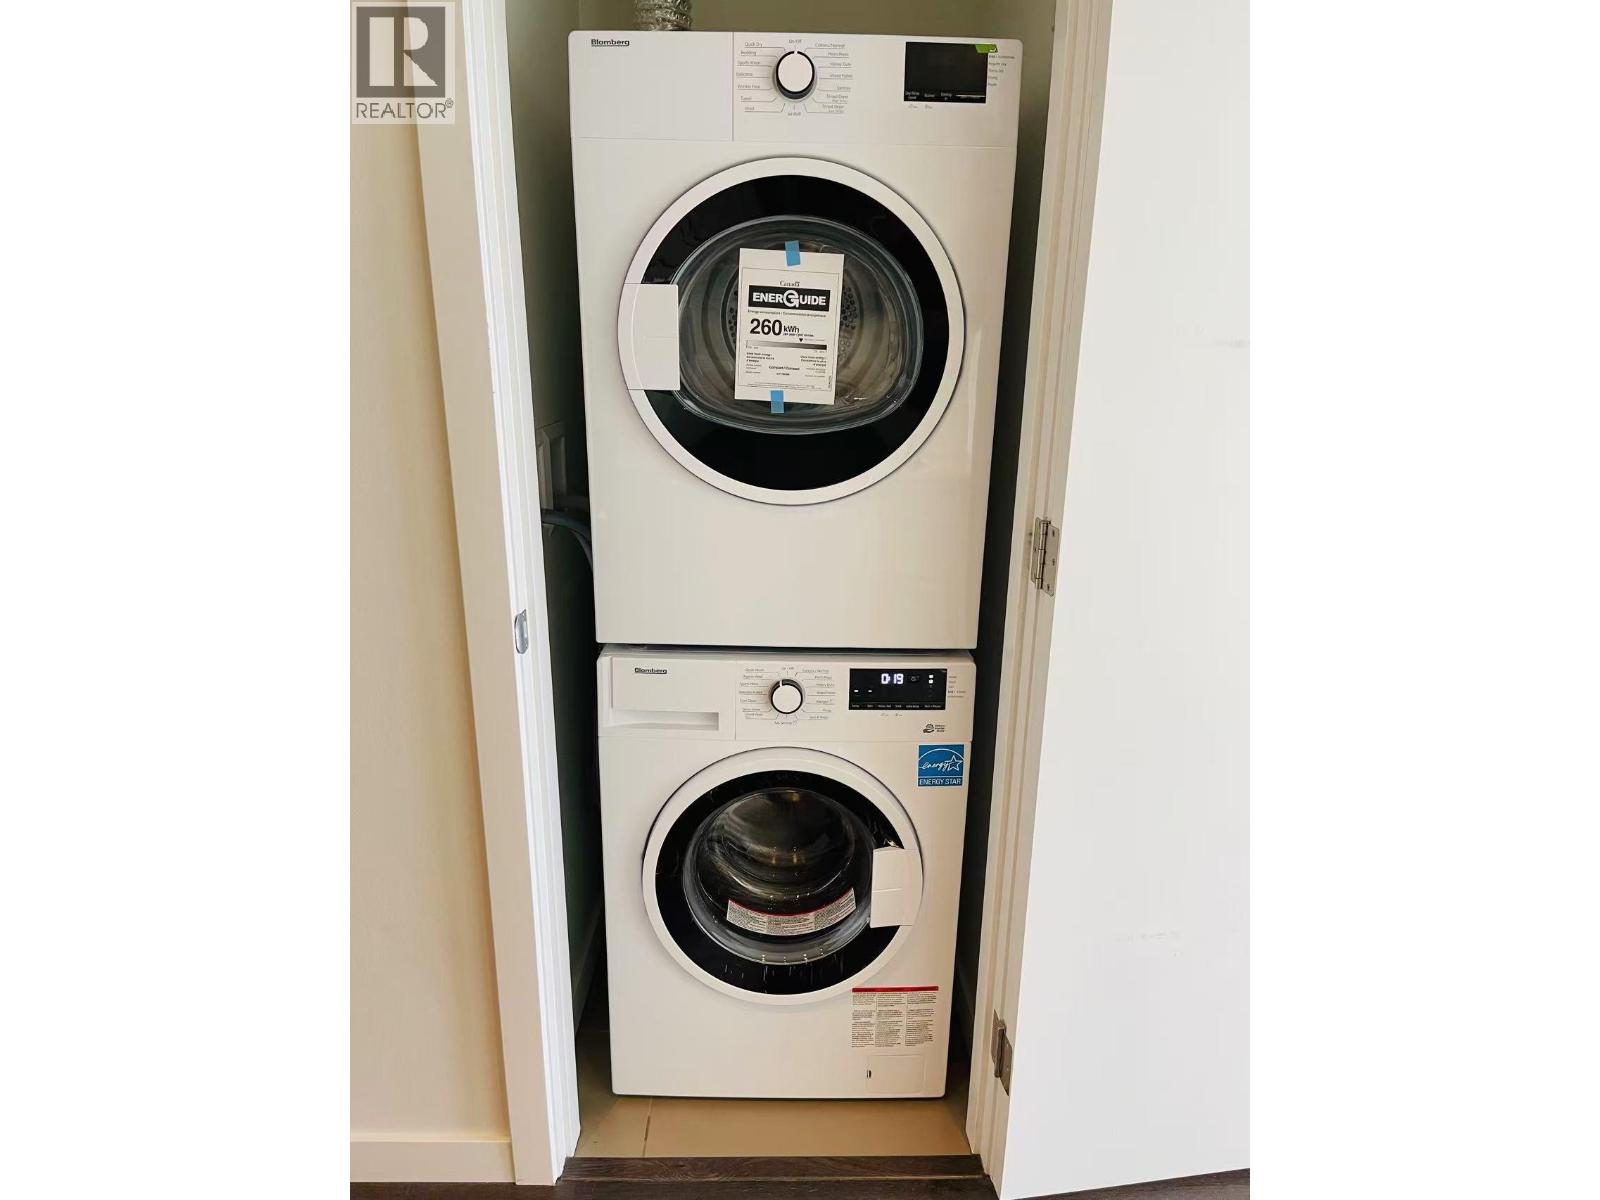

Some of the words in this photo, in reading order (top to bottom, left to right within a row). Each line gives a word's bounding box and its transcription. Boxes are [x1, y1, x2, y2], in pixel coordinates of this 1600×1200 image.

[591, 38, 630, 47] Blomberg
[752, 289, 827, 308] ENERGUIDE
[749, 318, 783, 336] 260
[783, 325, 800, 334] kWh
[919, 778, 945, 786] ENERGY
[945, 778, 962, 786] STAR
